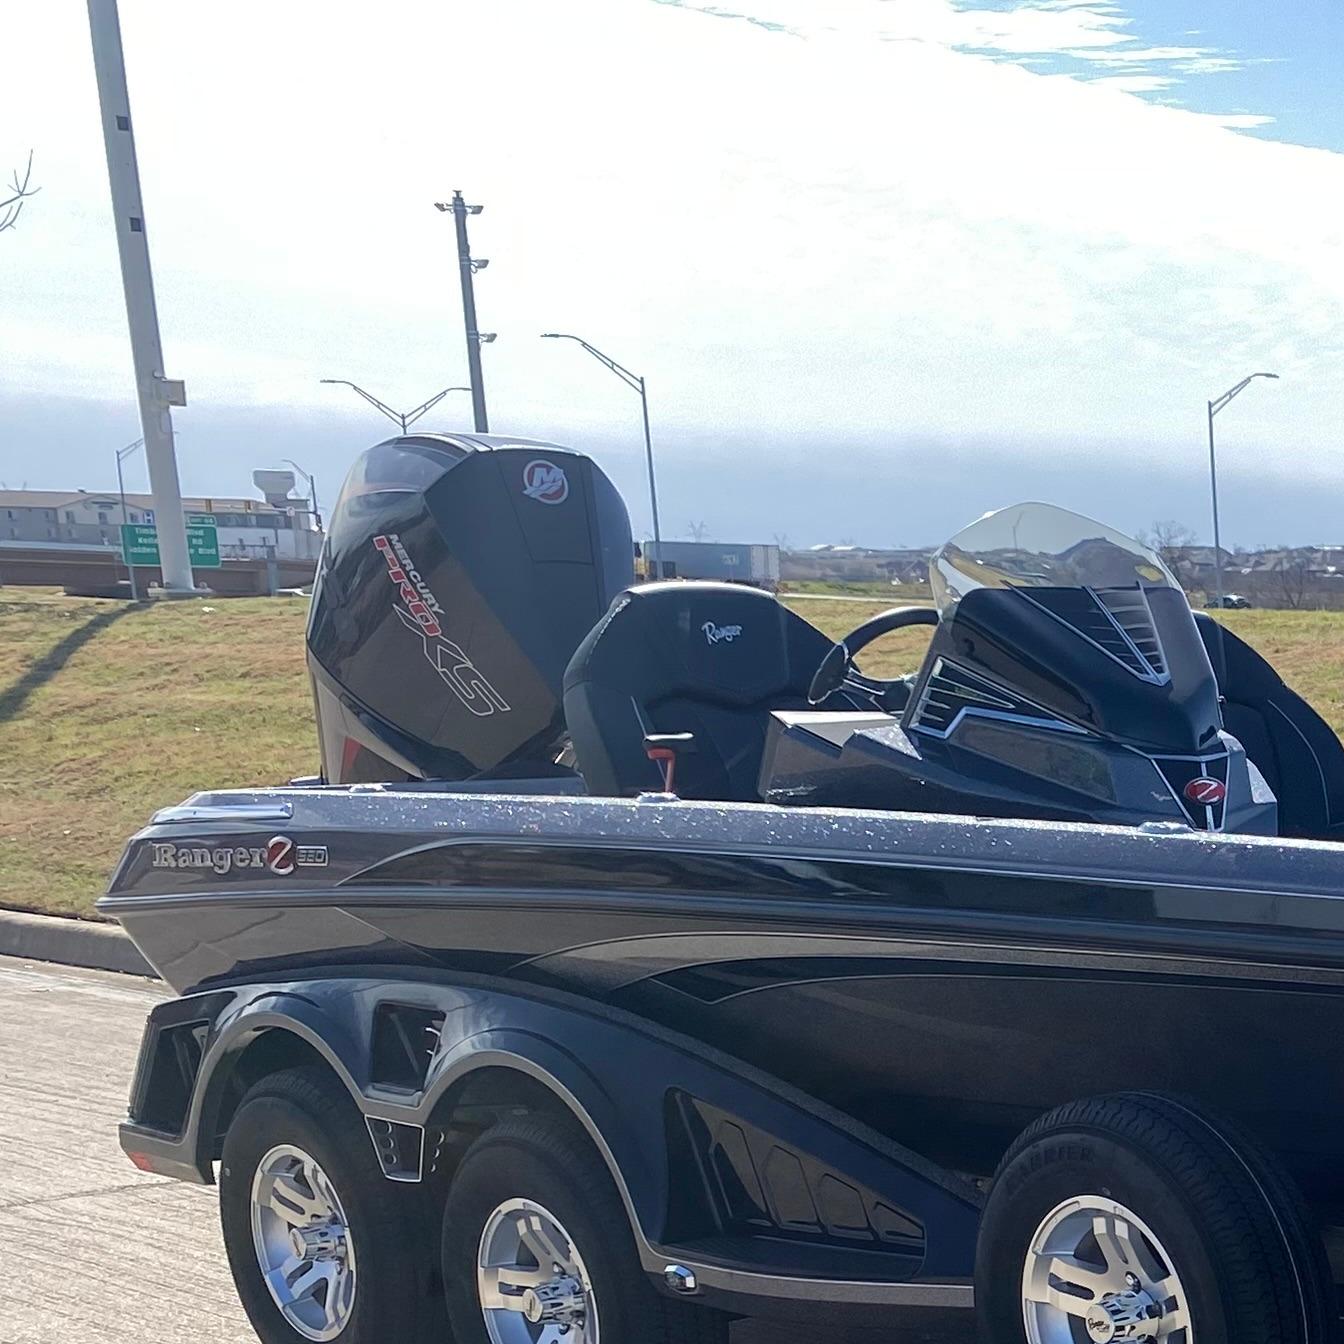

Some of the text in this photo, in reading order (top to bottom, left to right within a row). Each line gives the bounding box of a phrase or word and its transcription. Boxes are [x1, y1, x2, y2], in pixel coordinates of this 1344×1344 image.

[372, 535, 442, 637] PRO
[389, 533, 446, 615] MERCURY
[392, 602, 512, 716] XS
[152, 843, 268, 875] Ranger
